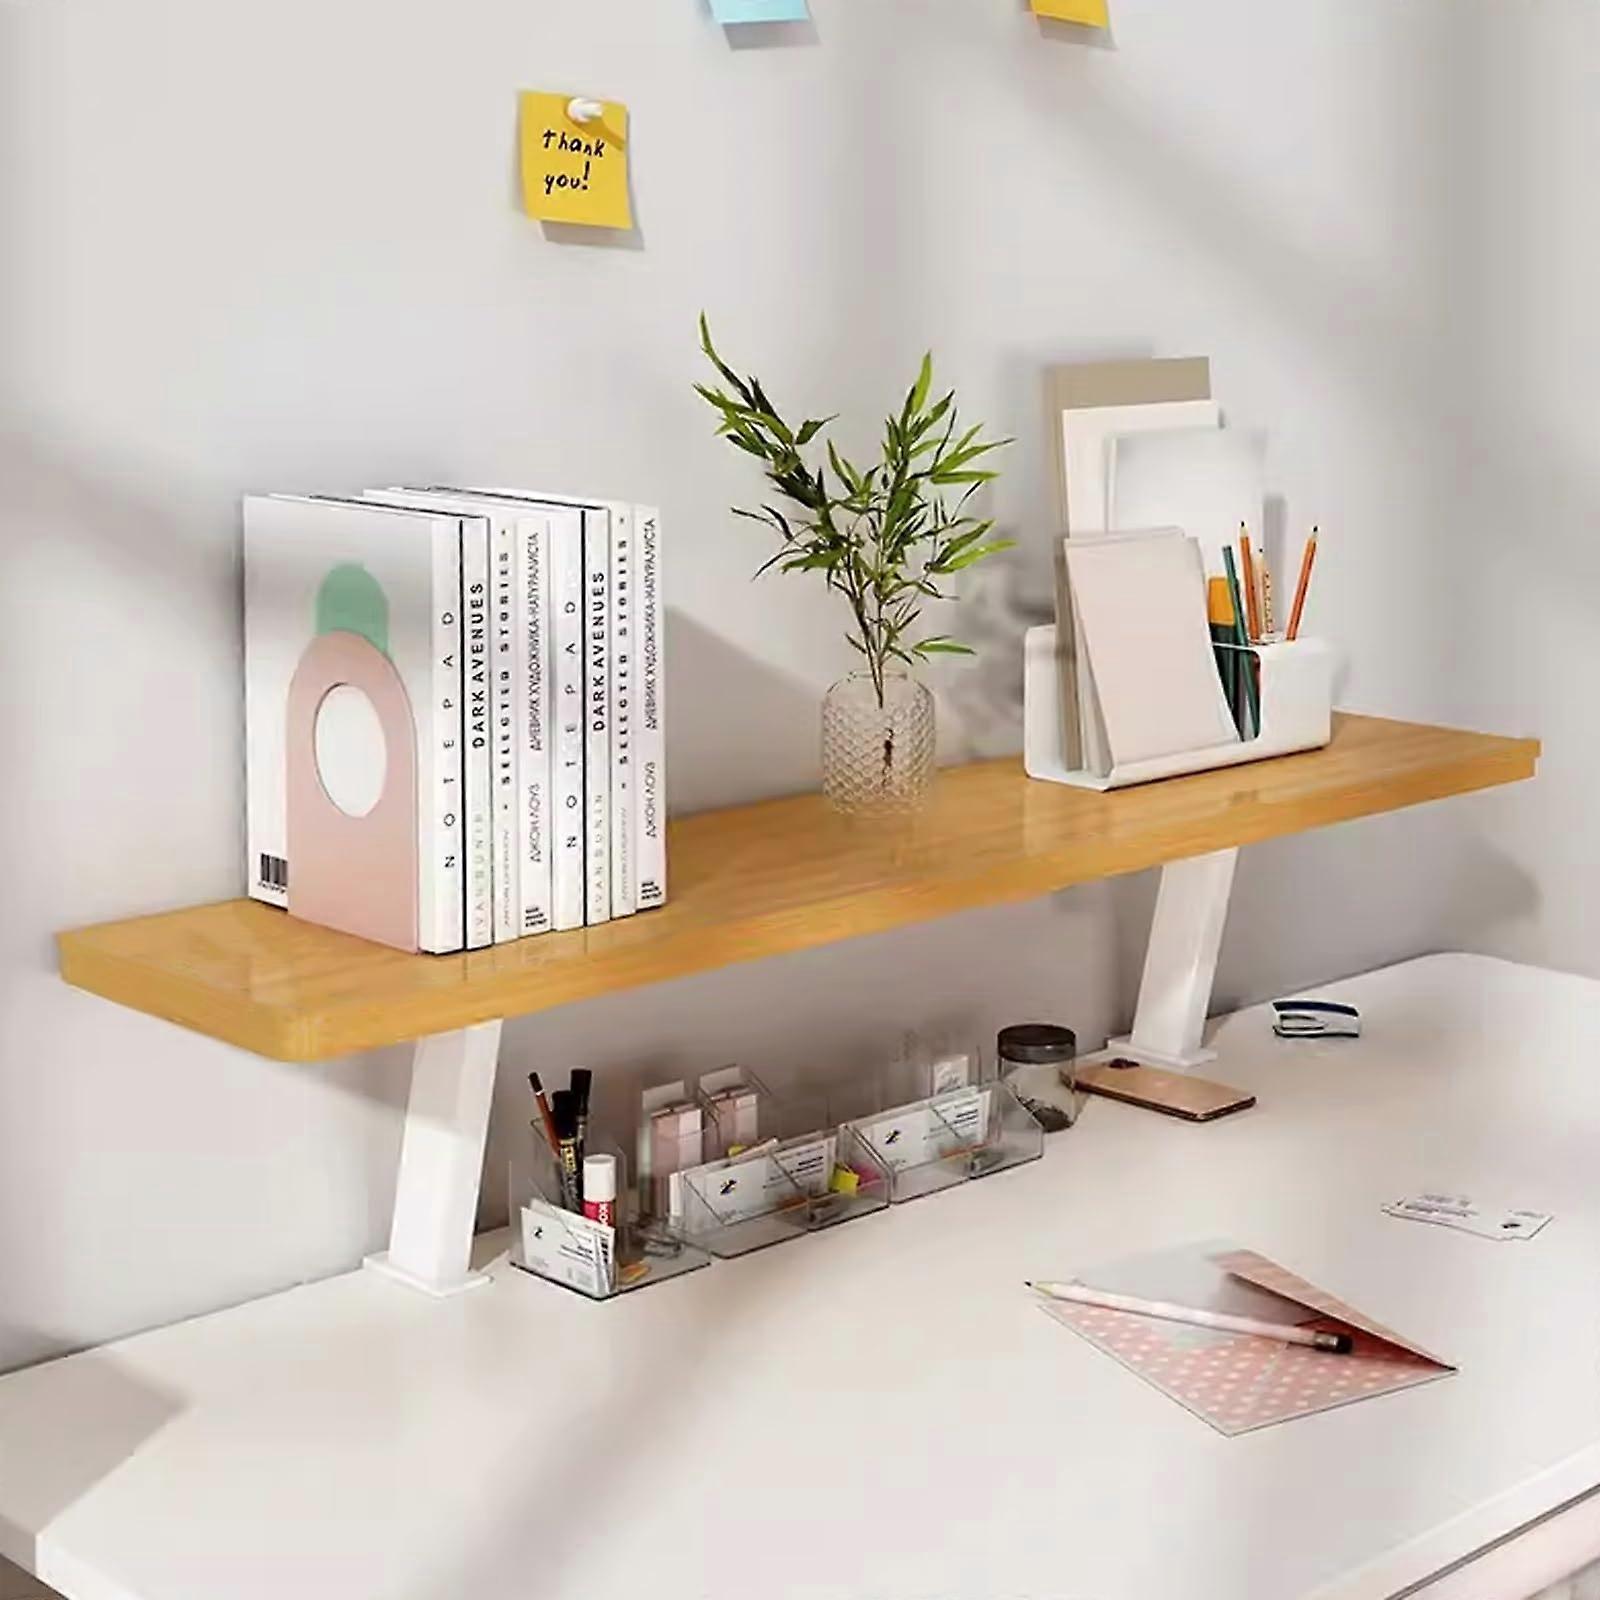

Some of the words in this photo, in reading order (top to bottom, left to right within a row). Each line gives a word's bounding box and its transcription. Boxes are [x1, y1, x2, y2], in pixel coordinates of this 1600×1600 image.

[544, 160, 590, 194] you!
[470, 583, 484, 682] AVENUES
[499, 552, 509, 653] STORIES
[592, 572, 604, 668] AVENUES
[618, 540, 628, 636] STORIES
[442, 611, 456, 868] NOTEPAD
[471, 690, 485, 749] DARK
[500, 671, 510, 785] SELECTED
[565, 602, 577, 849] NOTEPAD
[593, 675, 605, 731] DARK
[618, 655, 628, 765] SELECTED
